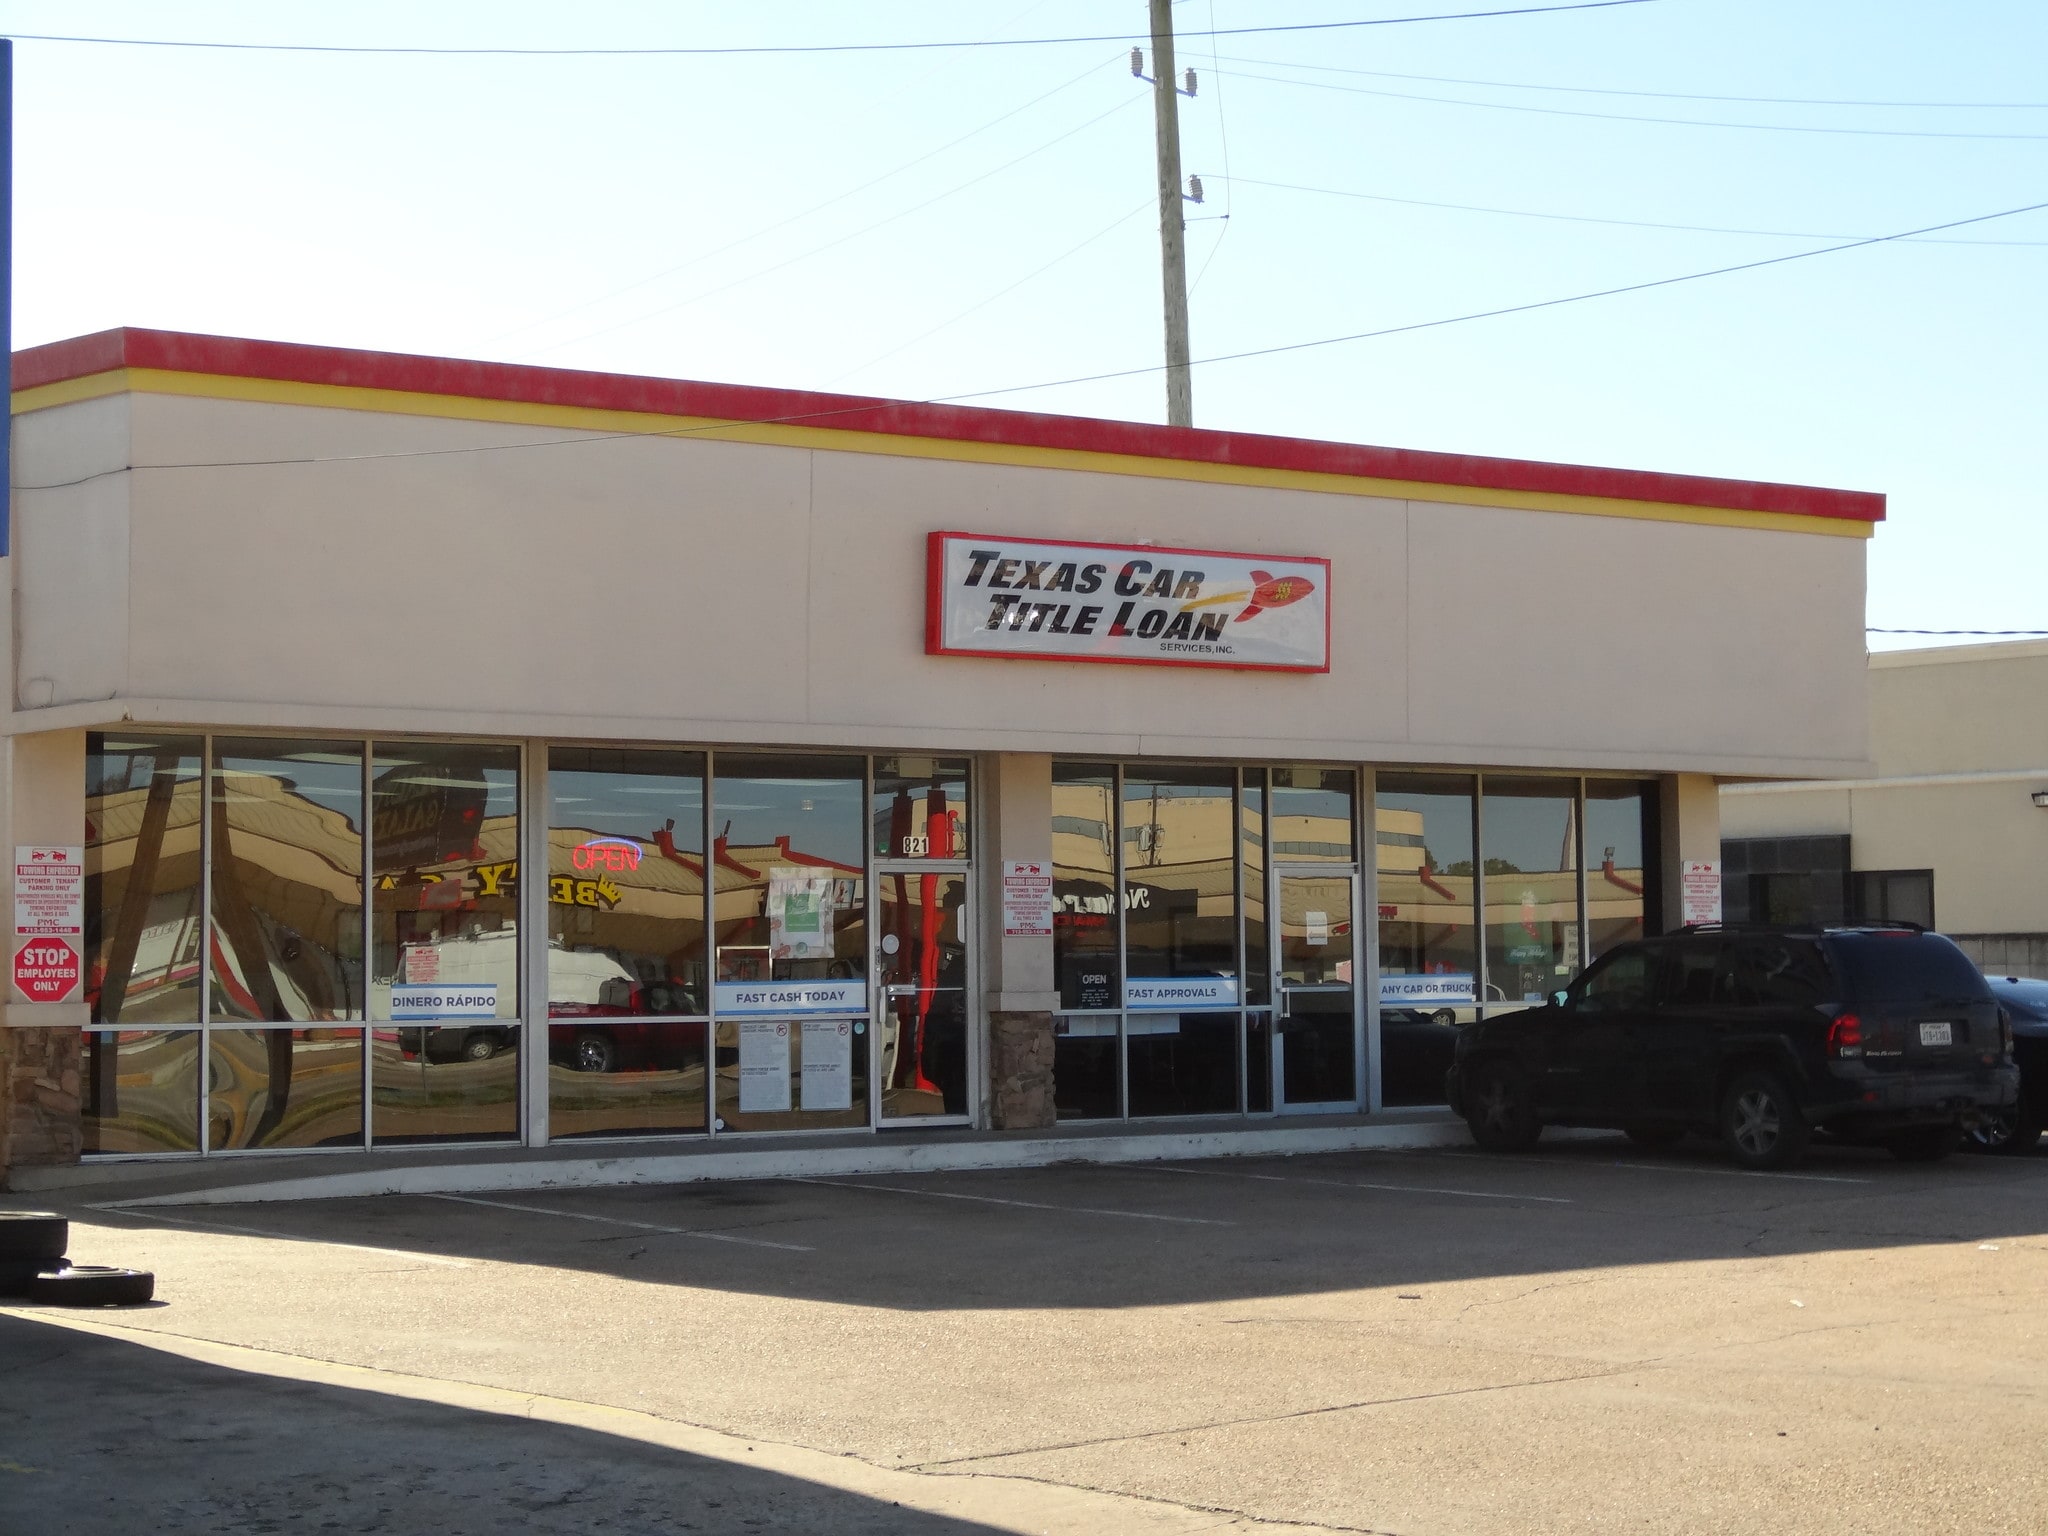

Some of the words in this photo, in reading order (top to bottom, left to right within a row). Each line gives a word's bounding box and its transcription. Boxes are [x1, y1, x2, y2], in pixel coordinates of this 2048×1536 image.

[963, 550, 1107, 593] TEXAS
[1113, 560, 1206, 600] CAR
[985, 593, 1104, 635] TITLE
[1107, 602, 1229, 643] LOAN
[904, 838, 928, 853] 821
[572, 844, 640, 871] OPEN
[23, 948, 70, 966] STOP
[17, 968, 76, 978] EMPLOYEES
[1082, 974, 1107, 985] OPEN
[33, 981, 60, 991] ONLY
[1381, 984, 1401, 994] ANY
[1403, 984, 1423, 994] CAR
[1425, 984, 1439, 993] OR
[1441, 983, 1471, 993] TRUCK
[736, 993, 767, 1003] FAST
[769, 992, 802, 1003] CASH
[804, 990, 846, 1002] TODAY
[1128, 988, 1154, 998] FAST
[1156, 988, 1217, 998] APPROVALS
[392, 996, 442, 1008] DINERO
[446, 994, 496, 1007] RÁPIDO
